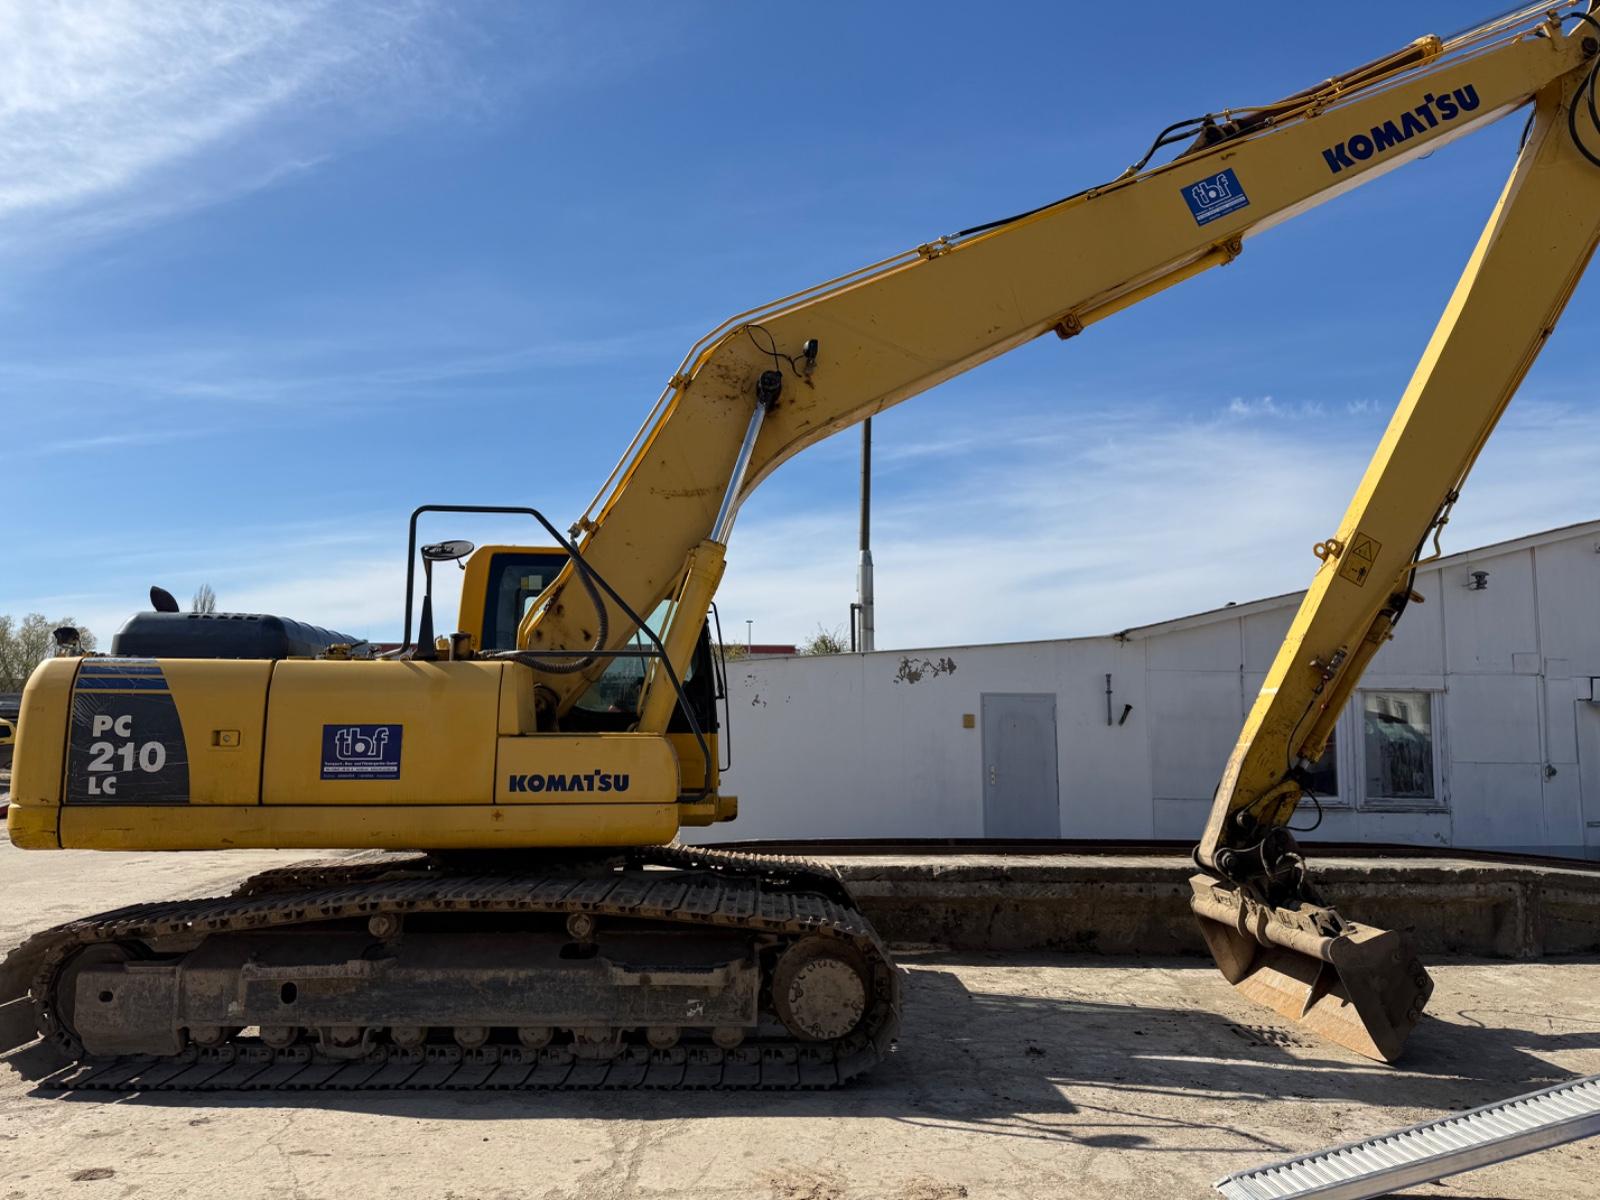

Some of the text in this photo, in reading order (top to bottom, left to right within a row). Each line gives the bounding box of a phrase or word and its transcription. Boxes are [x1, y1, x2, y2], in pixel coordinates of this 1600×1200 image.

[1322, 84, 1480, 174] KOMATSU
[1192, 173, 1232, 208] tbf
[92, 715, 132, 737] PC
[87, 741, 166, 773] 210
[335, 727, 389, 760] tbf
[88, 776, 117, 795] LC
[509, 769, 629, 792] KOMATSU
